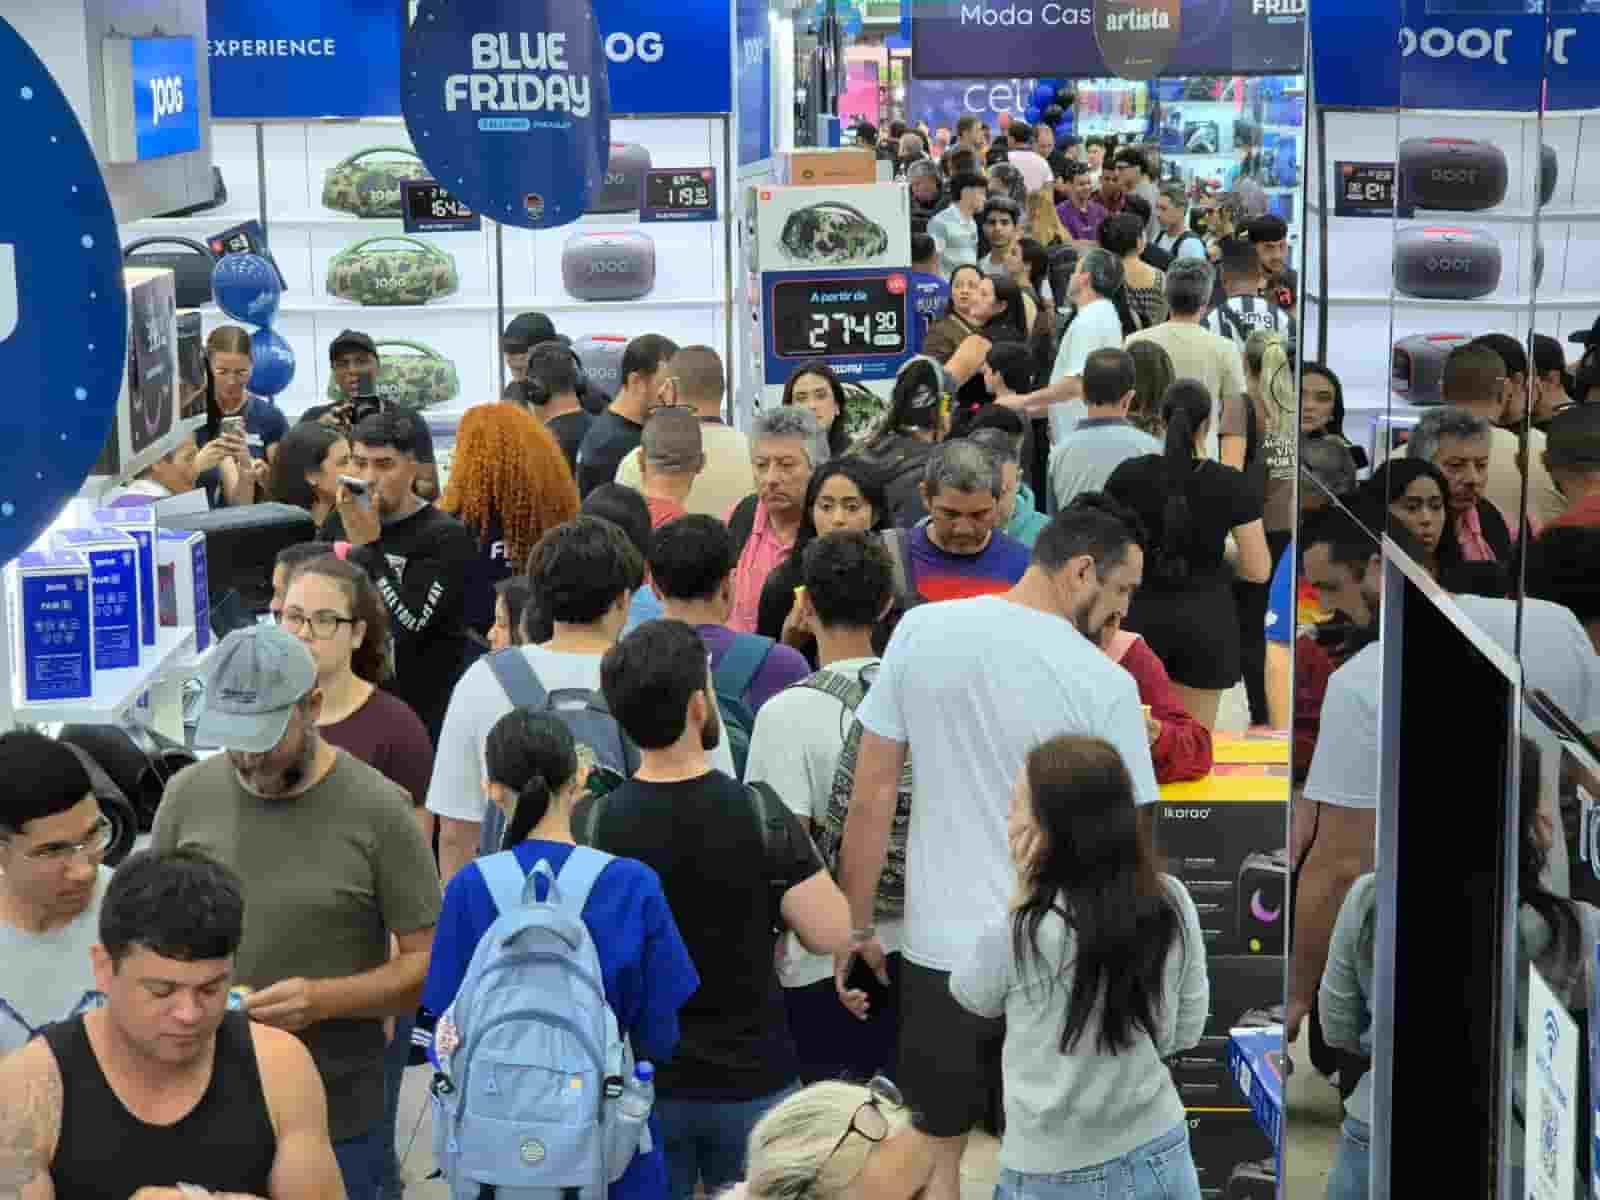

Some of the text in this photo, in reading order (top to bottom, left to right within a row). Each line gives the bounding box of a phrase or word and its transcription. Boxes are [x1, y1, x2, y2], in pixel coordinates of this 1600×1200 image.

[960, 4, 1033, 25] Moda
[1106, 8, 1170, 31] artista
[471, 32, 568, 71] BLUE
[445, 74, 591, 117] FRIDAY
[809, 312, 872, 349] 274
[875, 311, 897, 329] 90
